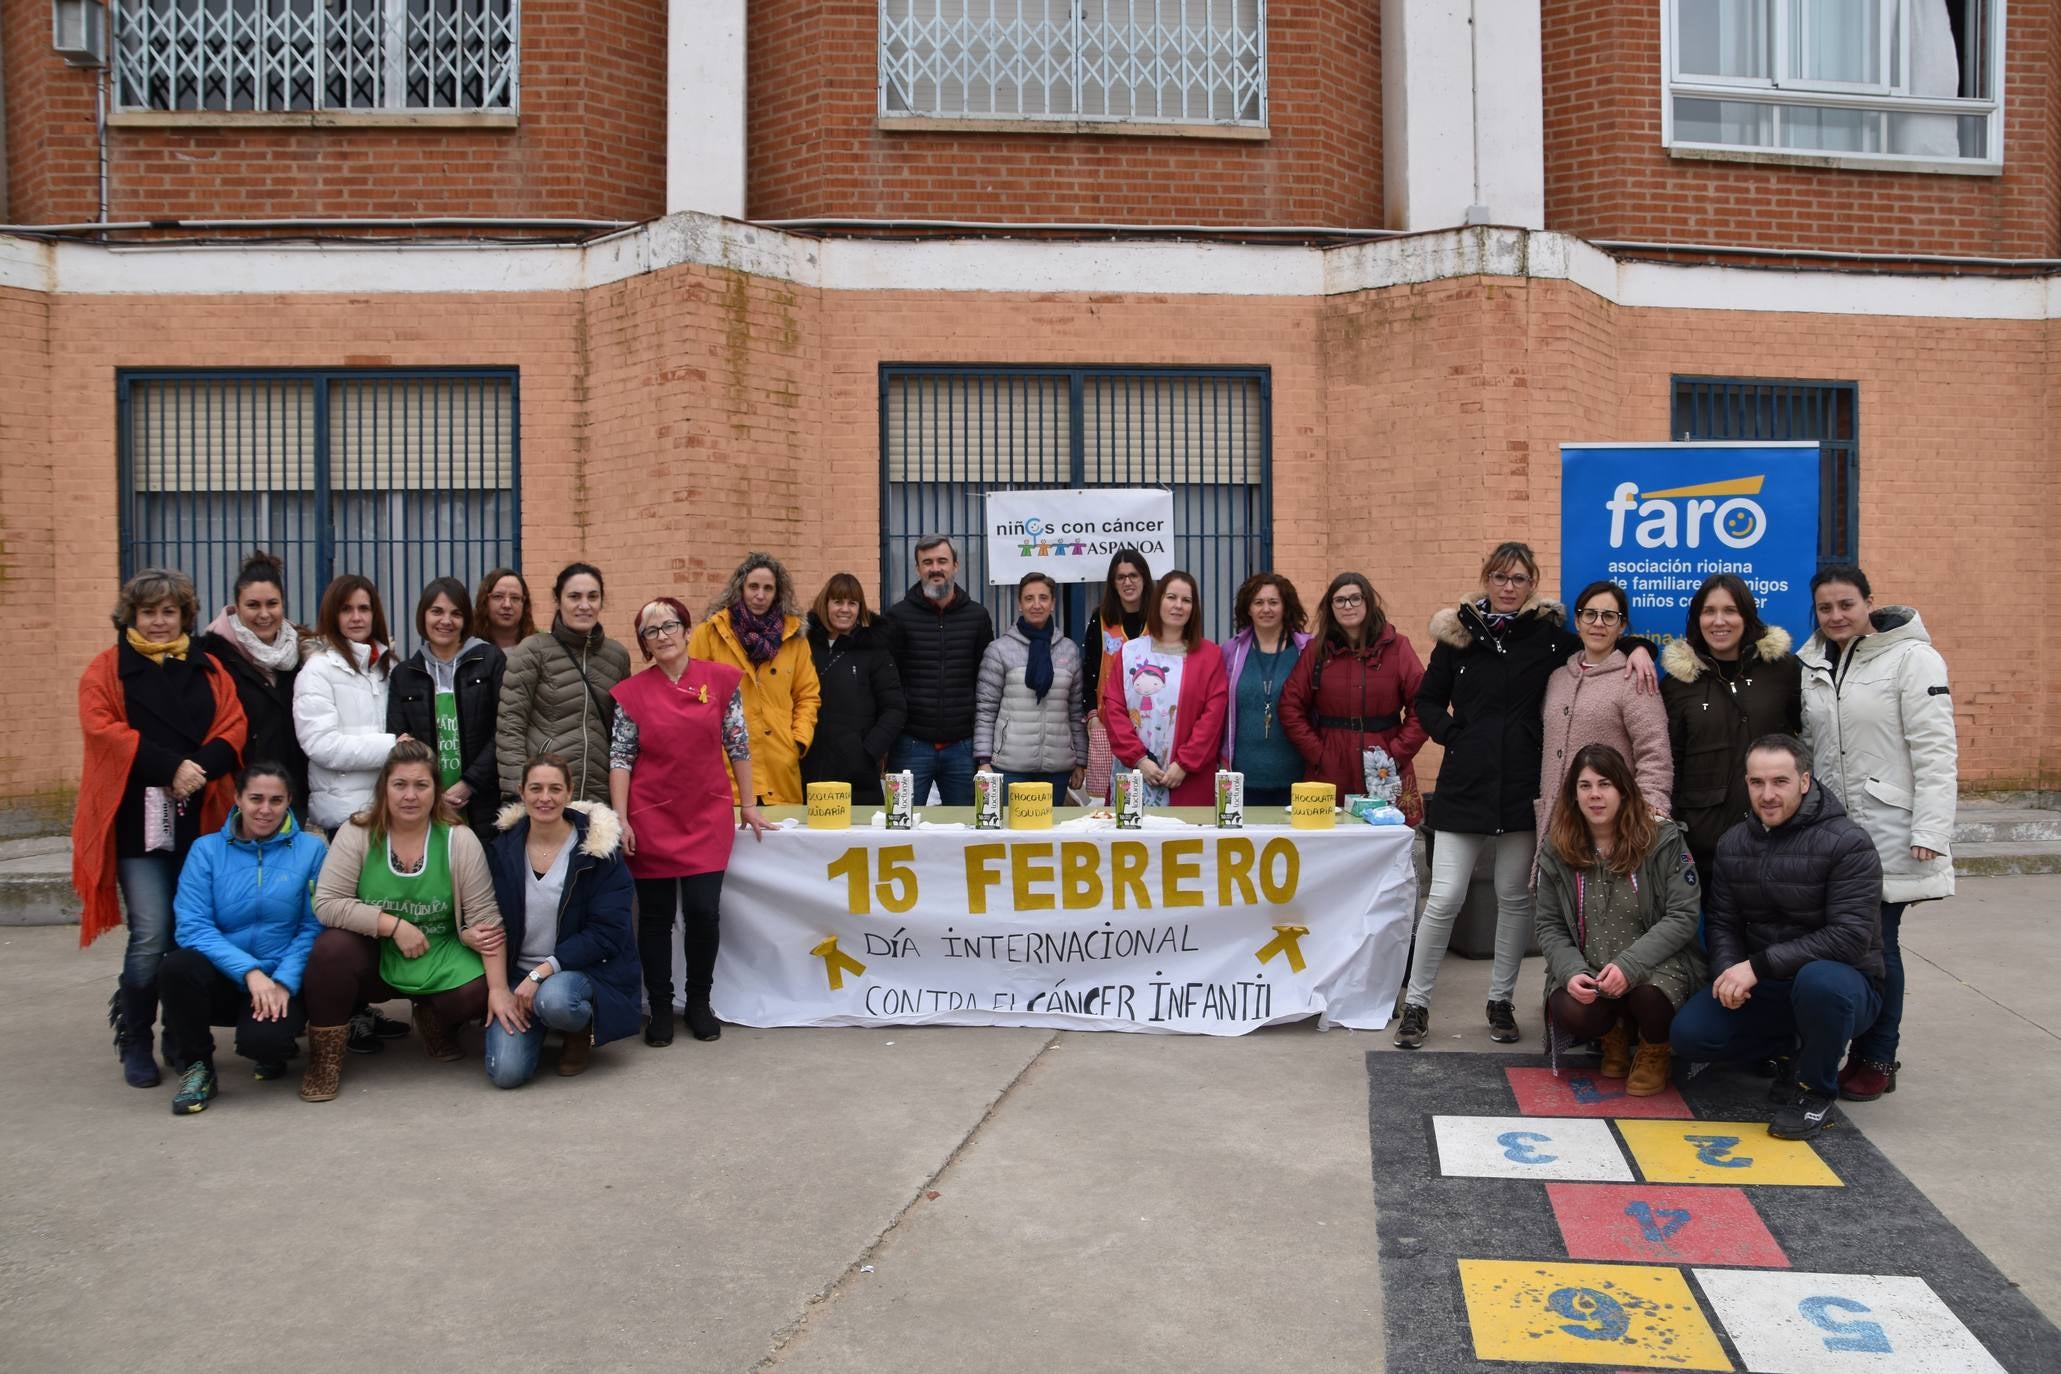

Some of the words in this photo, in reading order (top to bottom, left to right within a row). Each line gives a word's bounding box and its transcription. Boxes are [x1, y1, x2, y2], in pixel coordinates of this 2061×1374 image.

[1062, 522, 1095, 534] con
[1102, 518, 1164, 533] cáncer
[1606, 481, 1767, 549] faro
[1087, 540, 1165, 555] ASPANOA
[1608, 558, 1691, 573] asociación
[1632, 593, 1674, 607] niños
[1633, 576, 1702, 590] familiare
[827, 844, 918, 914] 15
[964, 837, 1299, 914] FEBRERO
[864, 927, 920, 958] DÍA
[941, 921, 1199, 964] INTERNACIONAL
[1495, 1130, 1559, 1165] 3
[1683, 1134, 1754, 1168] 2
[1623, 1200, 1693, 1243] 4
[1797, 1294, 1895, 1354] 5
